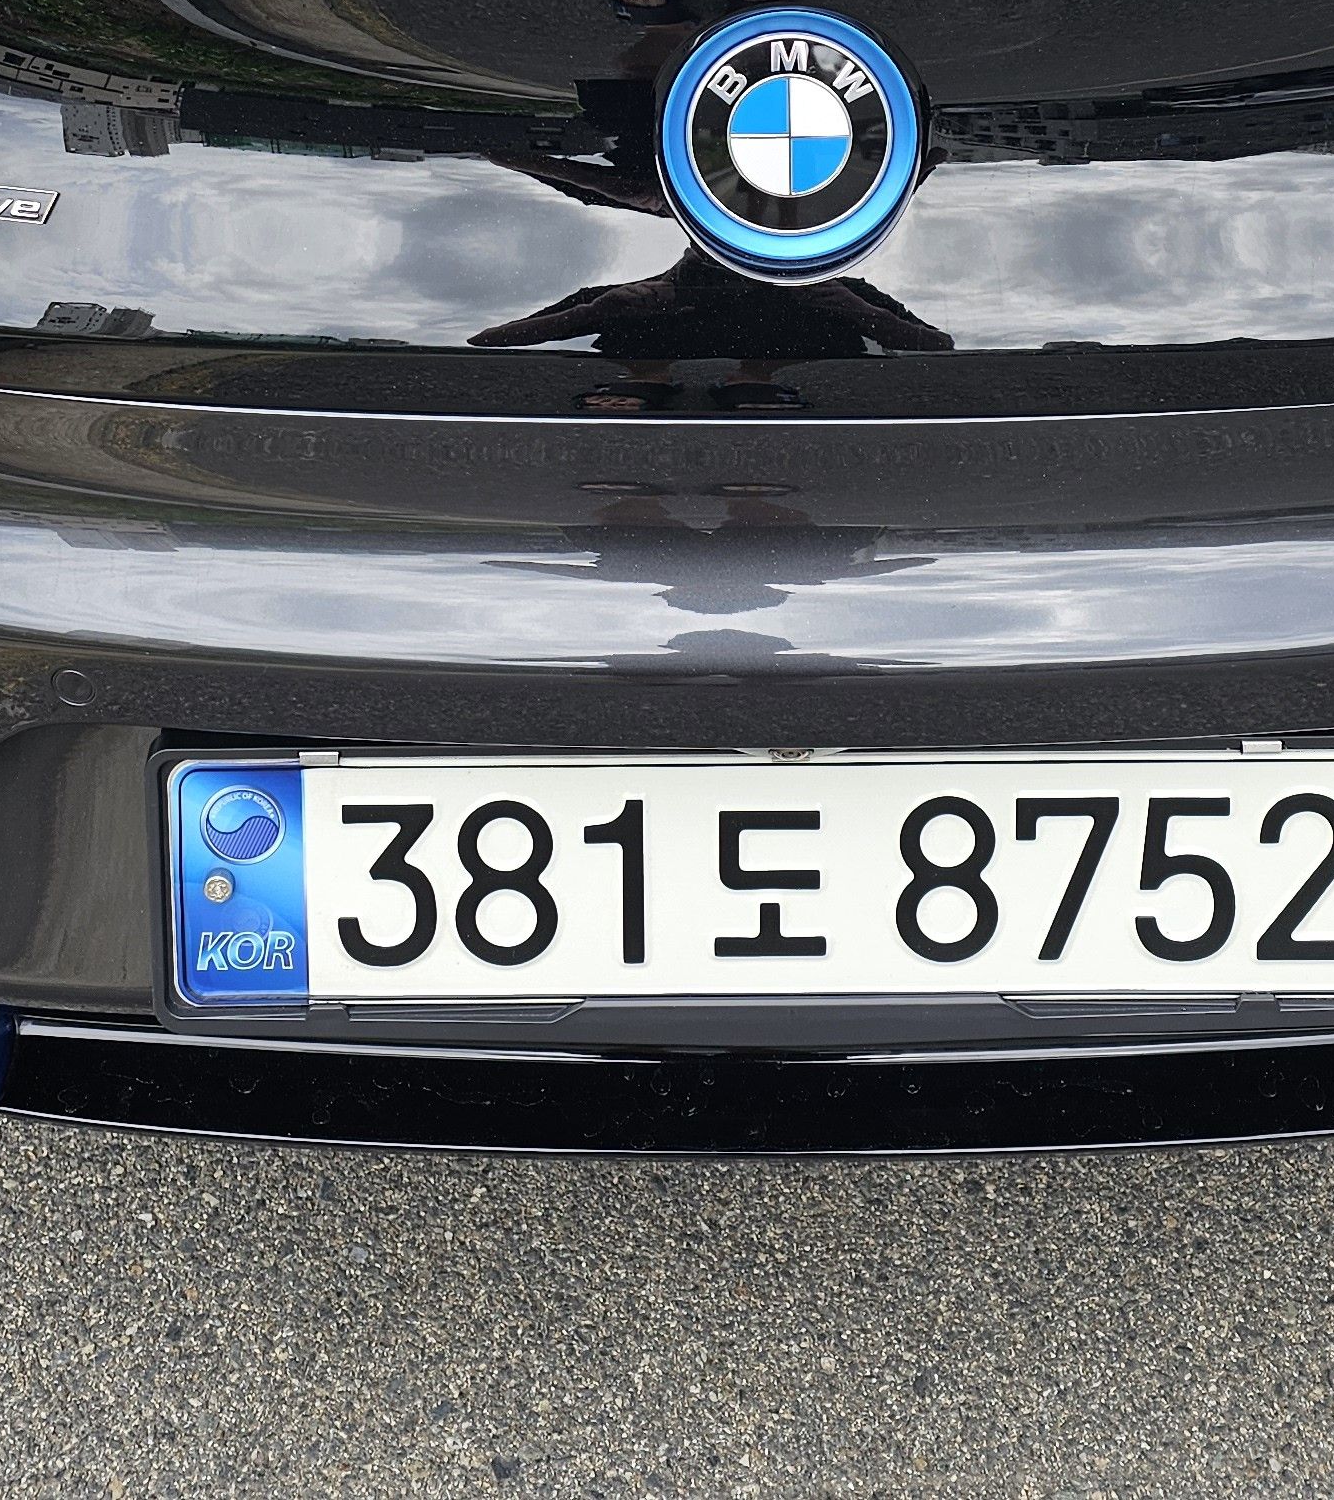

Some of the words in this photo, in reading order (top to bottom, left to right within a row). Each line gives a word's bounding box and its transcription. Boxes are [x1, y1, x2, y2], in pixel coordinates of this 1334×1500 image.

[707, 40, 874, 105] BMW
[337, 799, 827, 967] 381도
[196, 931, 297, 972] KOR
